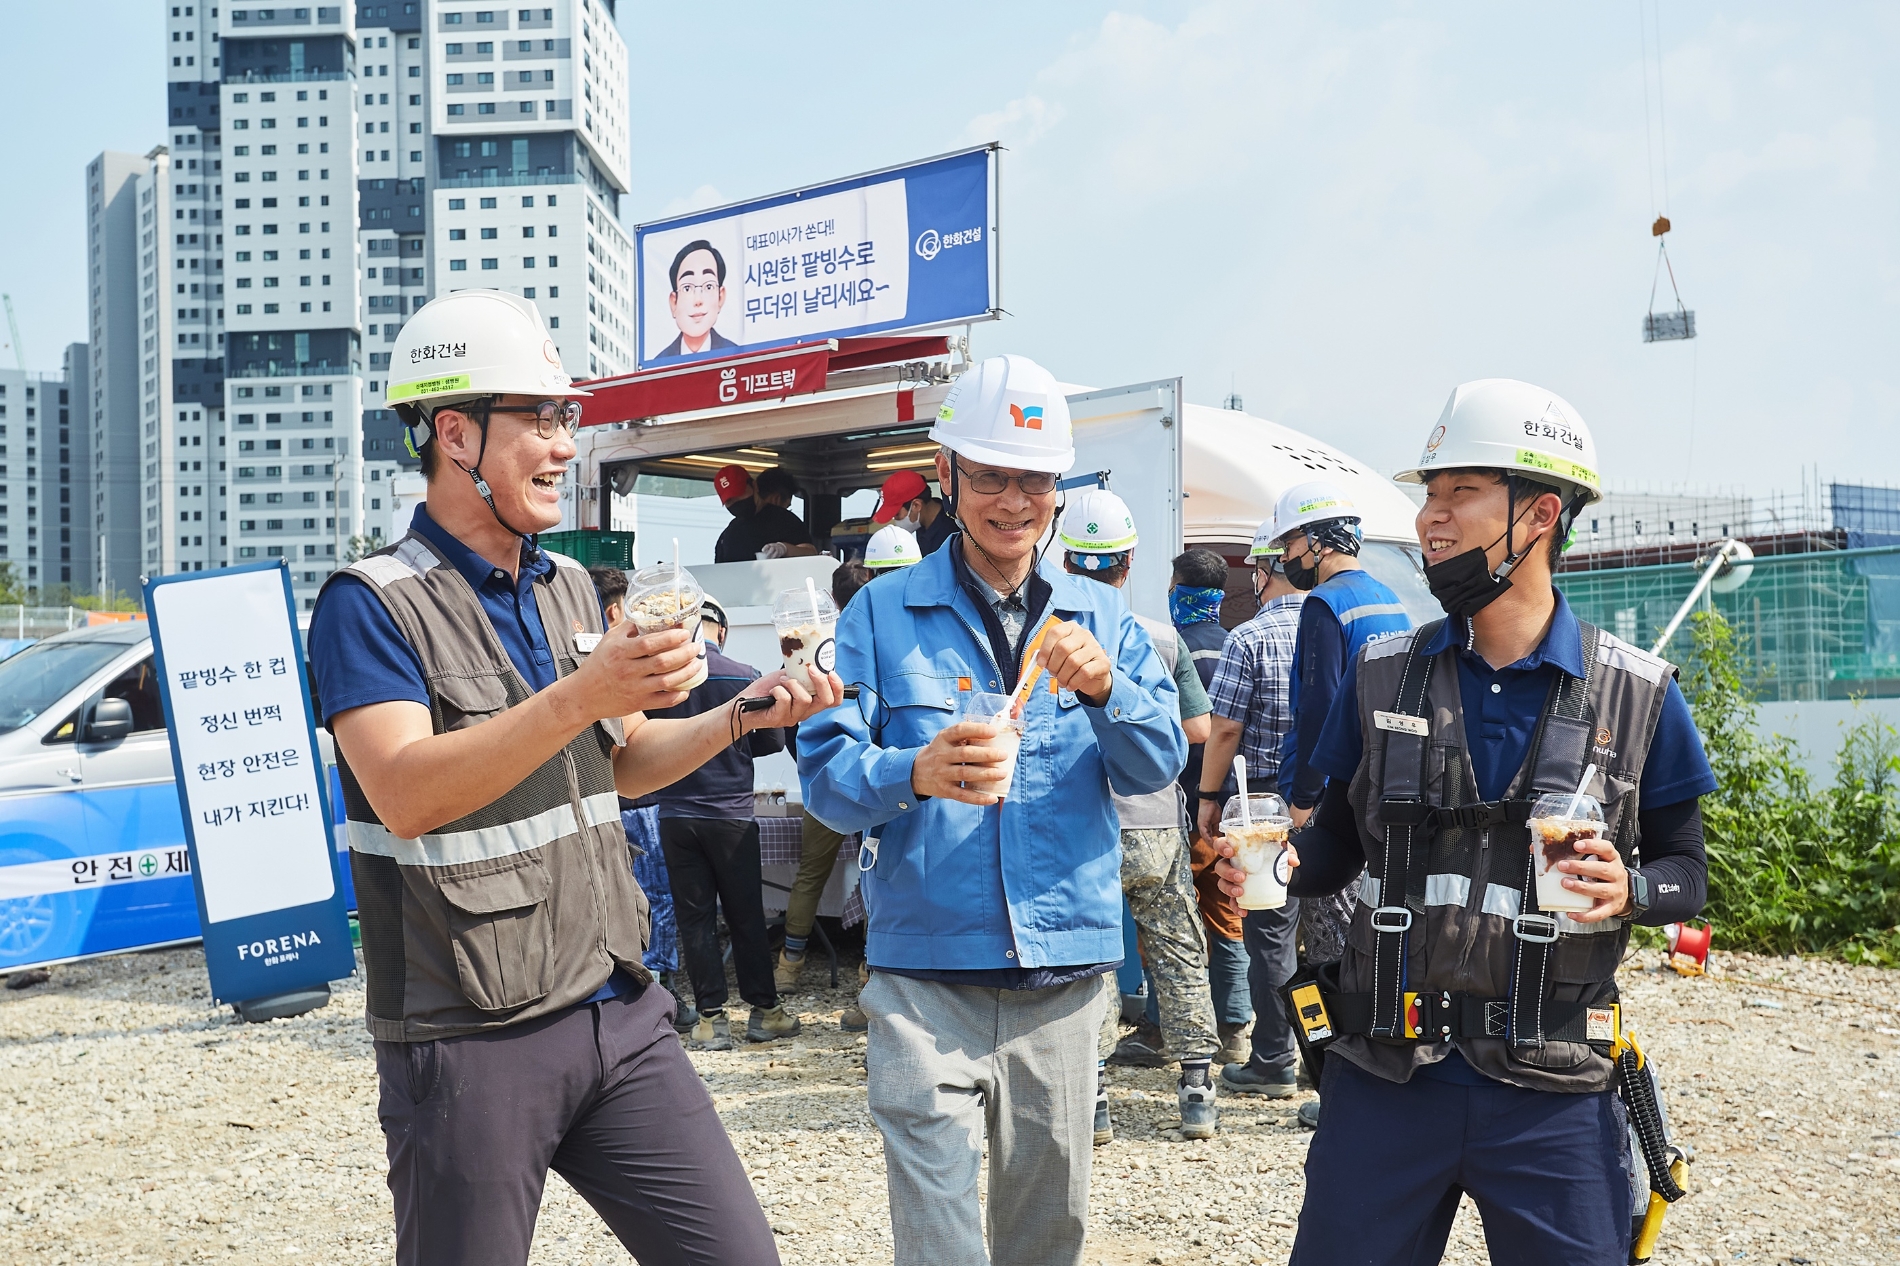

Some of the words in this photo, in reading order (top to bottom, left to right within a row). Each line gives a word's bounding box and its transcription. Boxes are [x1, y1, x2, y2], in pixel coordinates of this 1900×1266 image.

[746, 226, 802, 251] 대표이사가
[805, 218, 835, 240] 쏜다!!
[942, 226, 982, 249] 한화건설
[745, 256, 798, 288] 시원한
[801, 240, 876, 278] 팥빙수로
[745, 291, 798, 324] 무더위
[803, 278, 890, 314] 날리세요~
[410, 342, 466, 364] 한화건설
[740, 368, 796, 394] 기프트럭
[1523, 420, 1583, 451] 한화건설
[178, 665, 238, 690] 팥빙수
[243, 660, 262, 680] 한
[269, 656, 287, 676] 컵
[200, 711, 239, 734] 정신
[244, 704, 283, 726] 번쩍
[197, 758, 236, 782] 현장
[242, 748, 300, 774] 안전은
[1592, 746, 1617, 759] nwha
[203, 805, 242, 827] 내가
[248, 792, 310, 819] 지킨다!
[165, 850, 189, 873] 제
[236, 930, 322, 961] FORENA
[264, 956, 280, 967] 한화
[280, 952, 300, 964] 포레나
